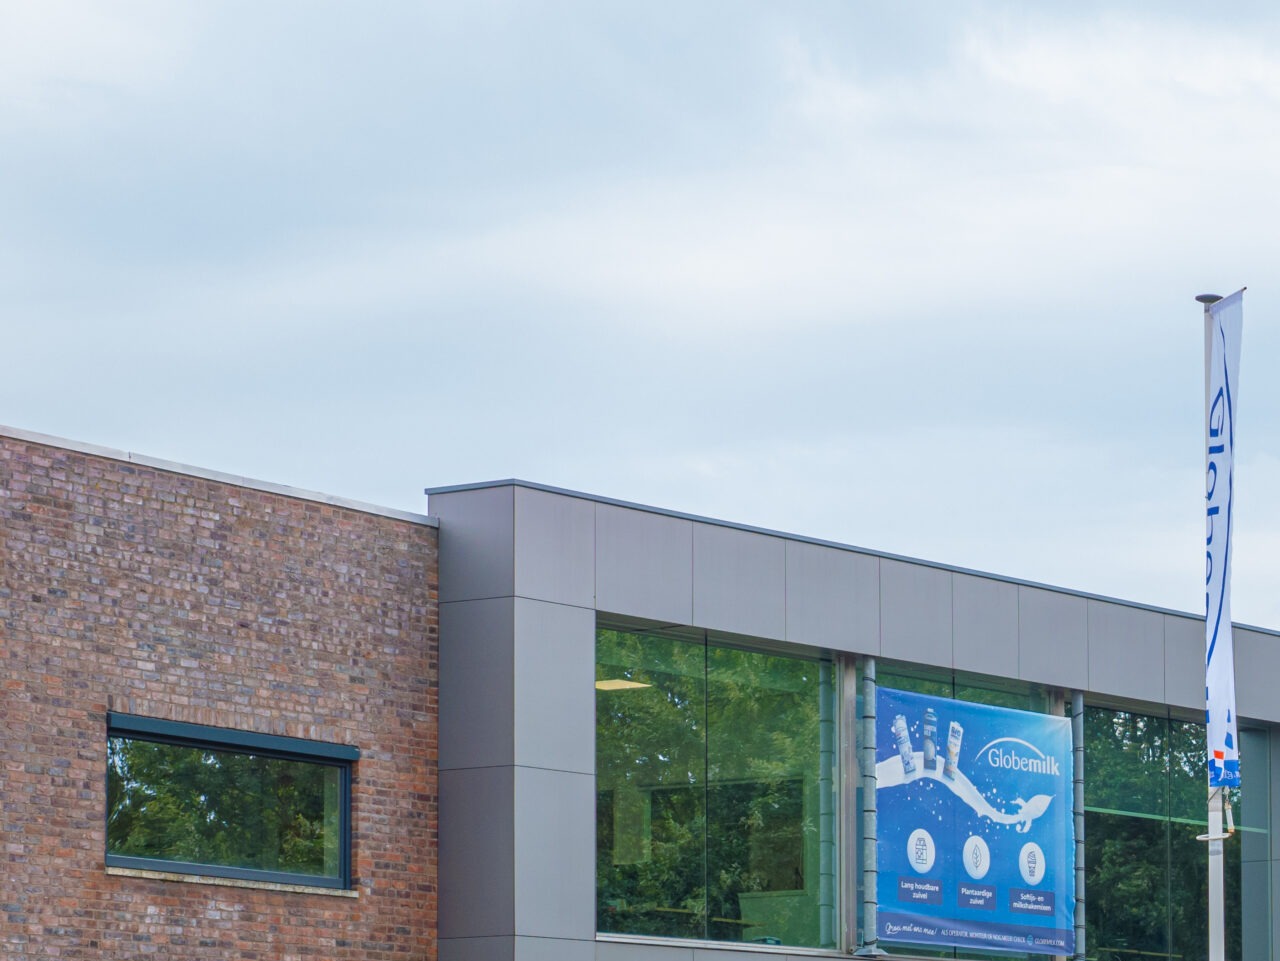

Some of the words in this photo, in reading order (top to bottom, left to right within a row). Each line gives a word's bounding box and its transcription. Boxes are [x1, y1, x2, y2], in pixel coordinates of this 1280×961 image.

[988, 748, 1060, 776] Globemilk
[901, 881, 914, 890] Lang
[915, 882, 939, 891] houdbare
[961, 888, 992, 898] Plantaardige
[969, 897, 984, 905] zuivel
